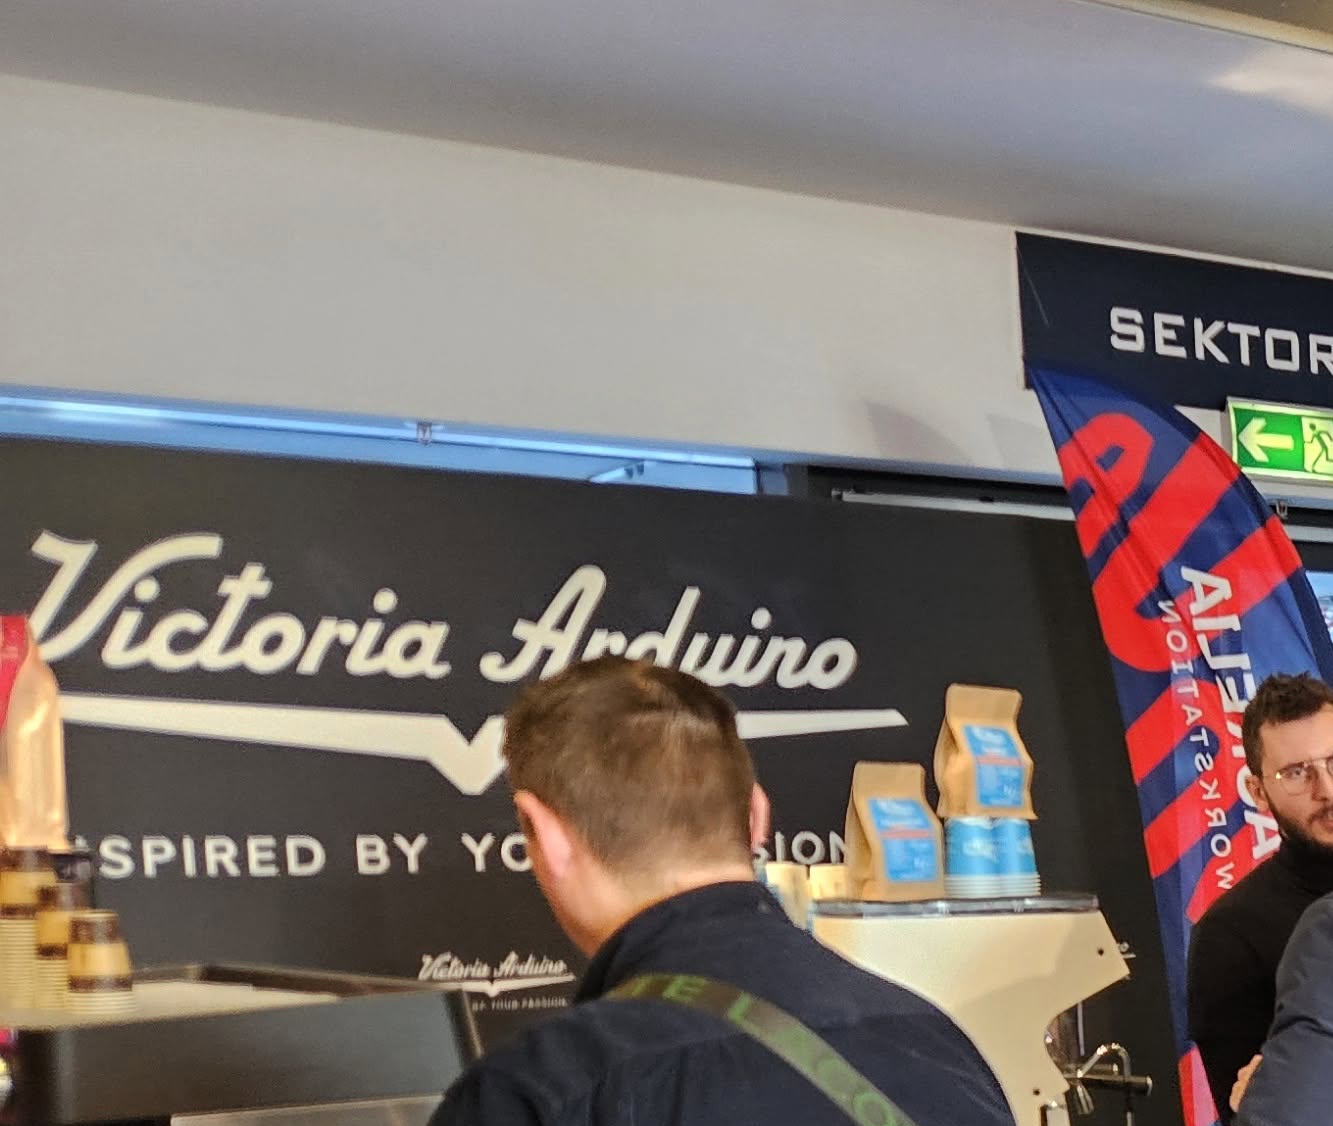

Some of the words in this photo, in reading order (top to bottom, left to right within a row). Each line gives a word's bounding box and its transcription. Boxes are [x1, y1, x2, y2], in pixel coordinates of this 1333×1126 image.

[27, 528, 453, 680] Victoria
[479, 563, 858, 691] Arduino
[75, 832, 327, 880] SPIRED
[355, 832, 428, 876] BY
